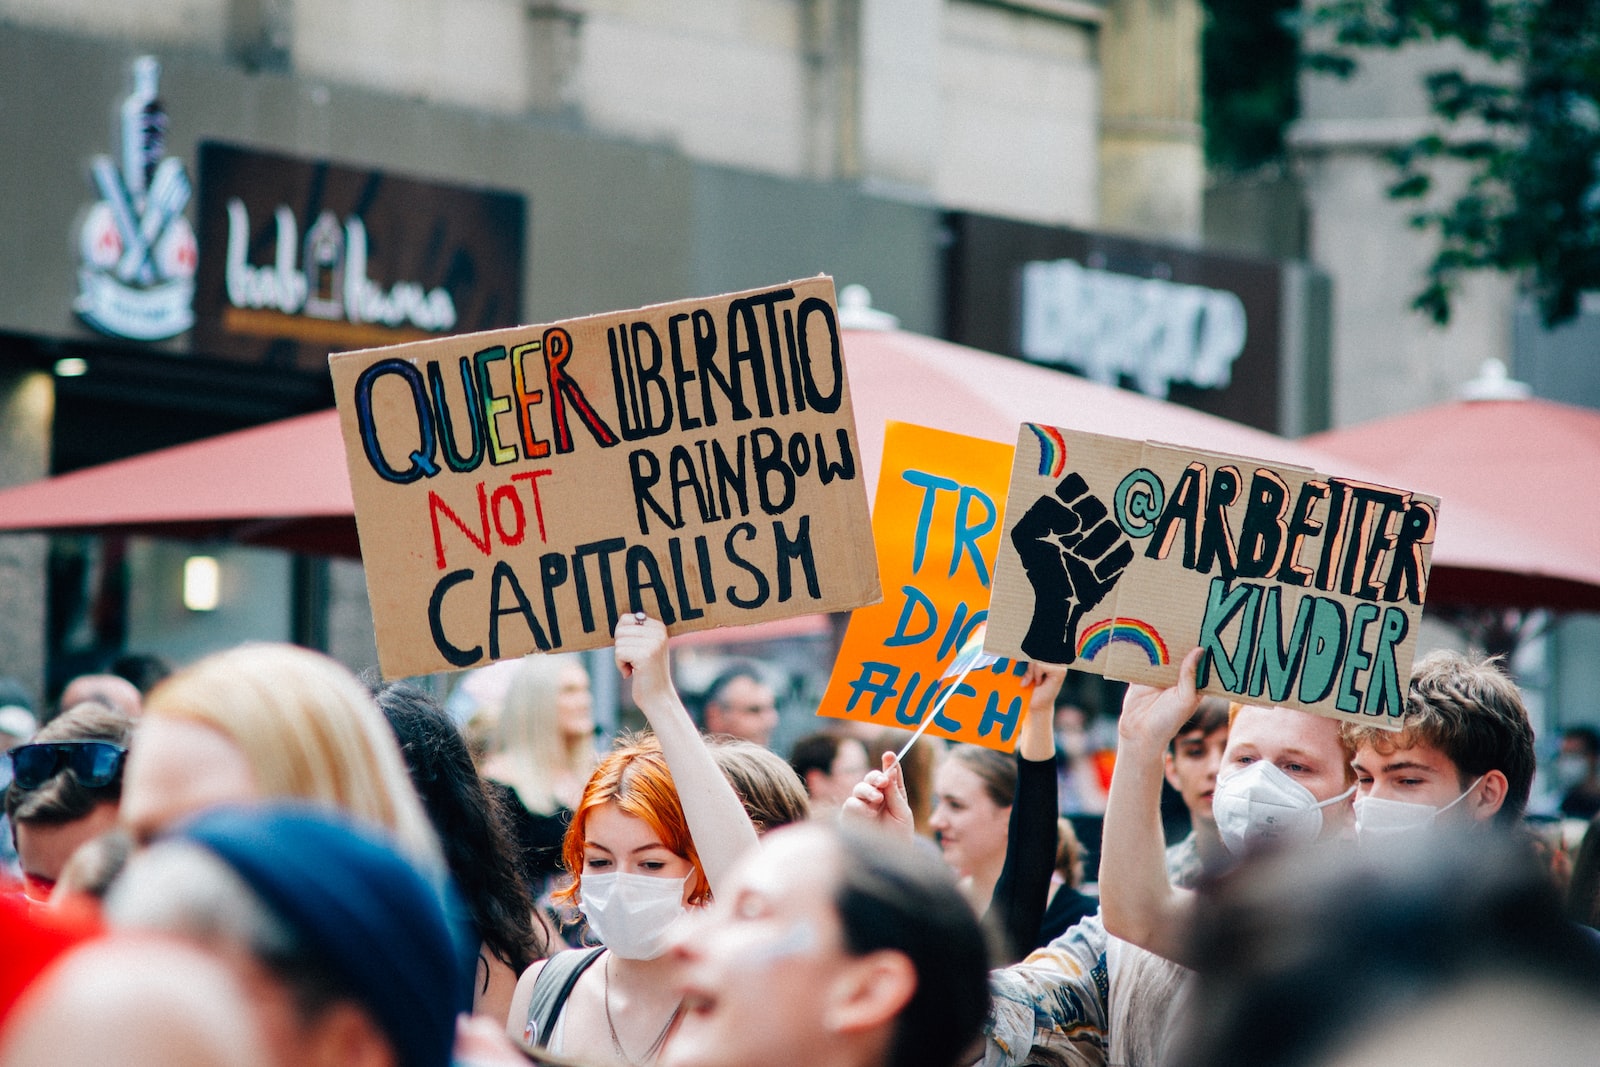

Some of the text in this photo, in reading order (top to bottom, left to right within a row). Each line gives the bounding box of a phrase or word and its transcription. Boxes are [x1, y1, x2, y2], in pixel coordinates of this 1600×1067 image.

[355, 327, 620, 485] QUEER
[607, 288, 843, 442] LIBERATIO
[428, 427, 856, 570] NOT RAINBOW
[902, 469, 997, 590] TR
[1113, 461, 1437, 605] @ARBEITER
[428, 514, 822, 667] CAPITALISM
[1195, 576, 1409, 718] KINDER
[846, 661, 1022, 742] AUCH
